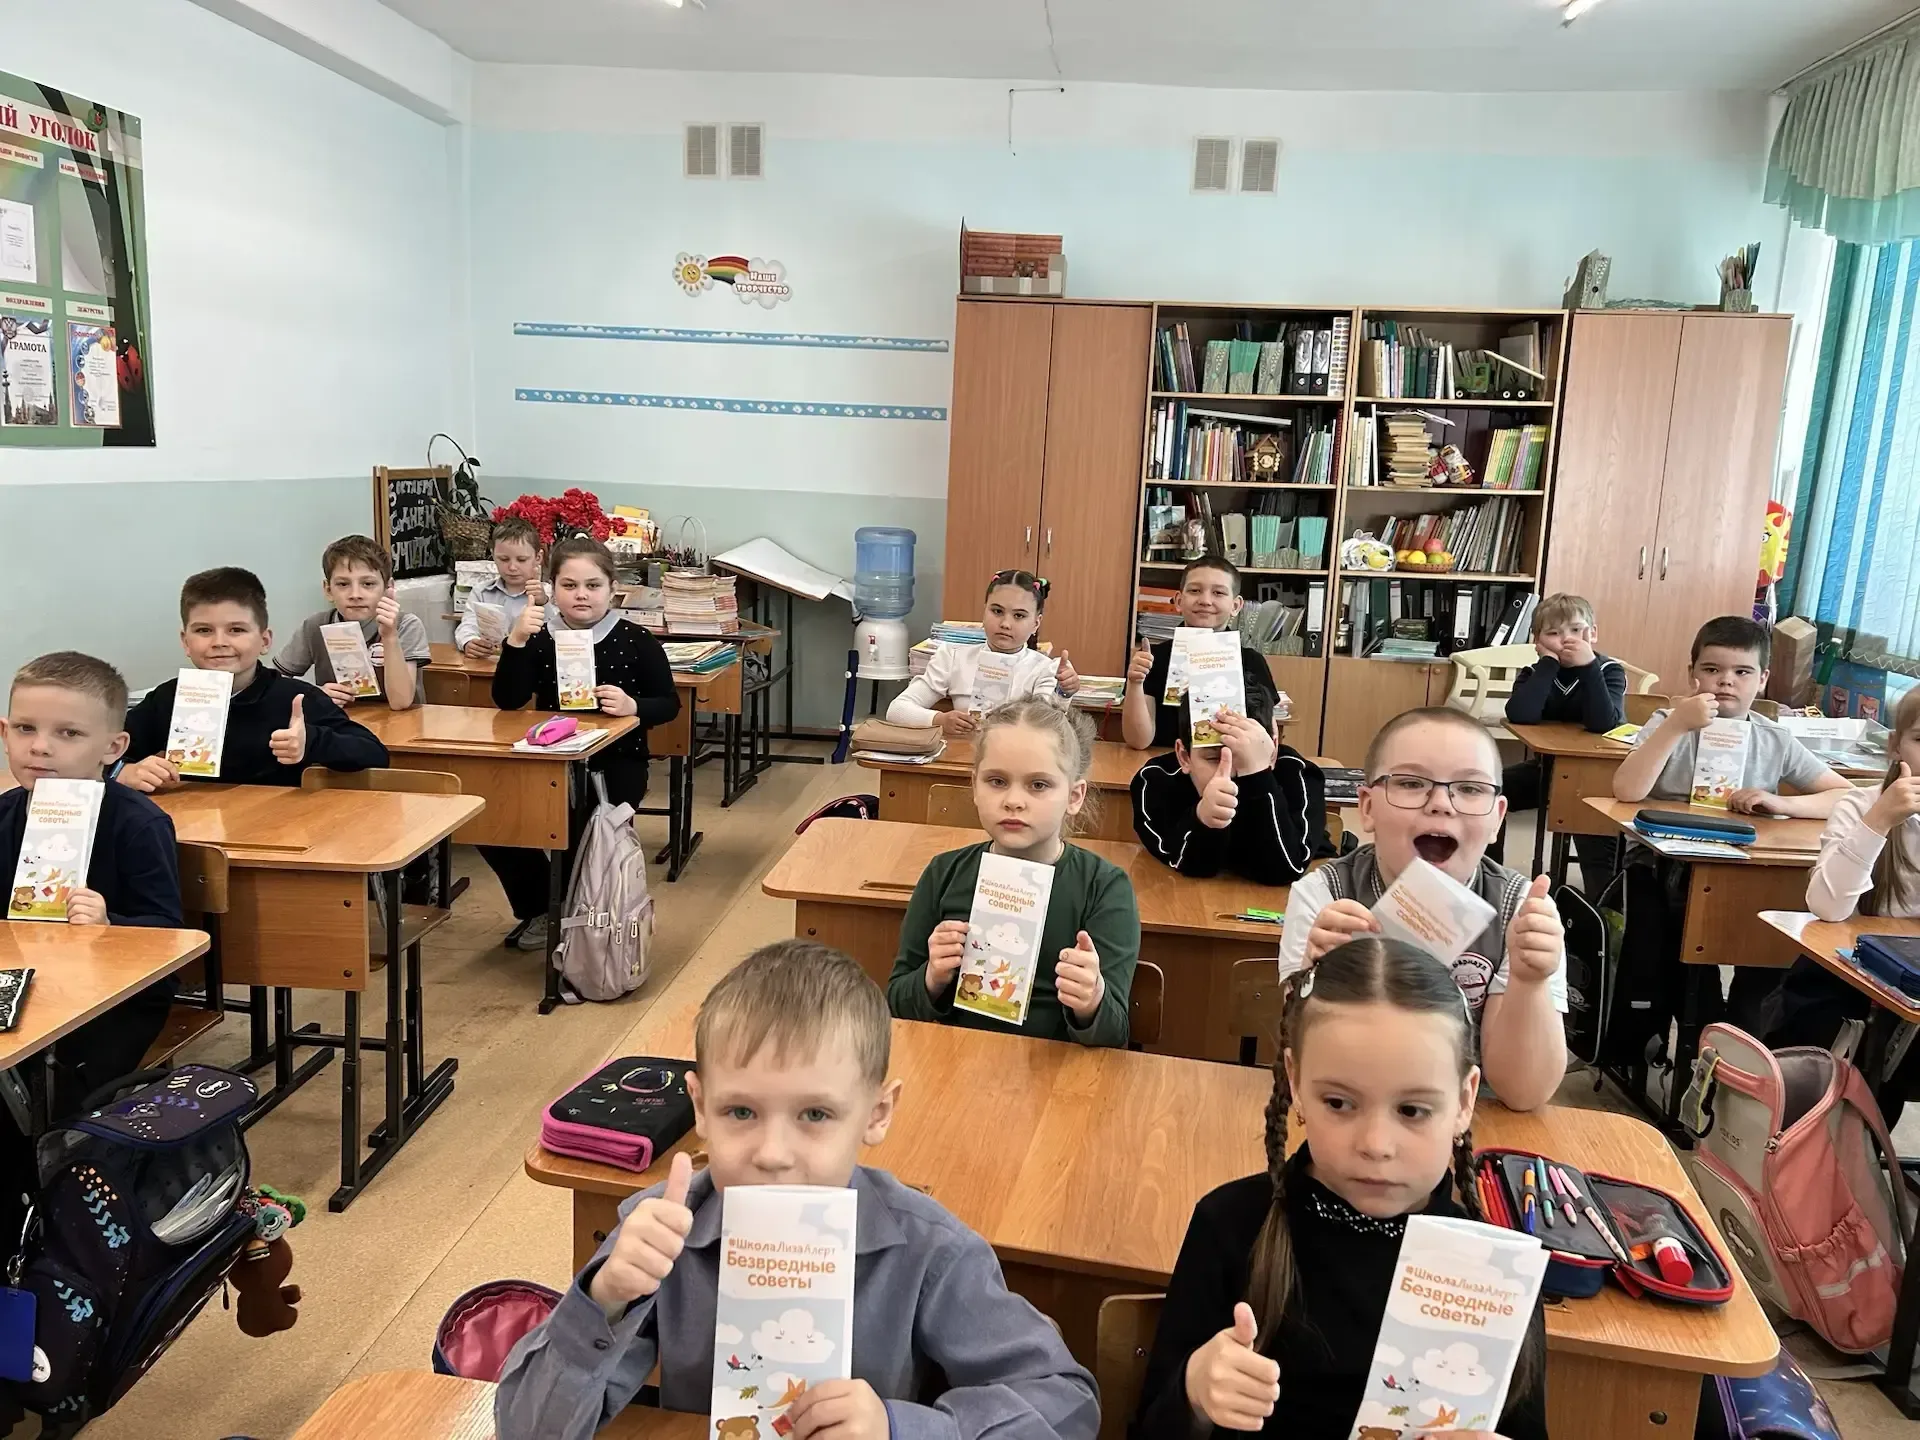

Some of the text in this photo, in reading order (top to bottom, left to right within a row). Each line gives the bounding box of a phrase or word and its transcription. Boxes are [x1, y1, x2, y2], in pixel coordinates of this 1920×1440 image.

[28, 113, 97, 152] УГОЛОК
[9, 341, 47, 353] ГРАМОТА
[978, 885, 1036, 907] Безвредные
[988, 898, 1022, 913] советы
[728, 1237, 836, 1257] #ШколаЛизаАлерт
[727, 1251, 836, 1275] Безвредные
[747, 1273, 812, 1289] советы
[1400, 1277, 1514, 1317] Безвредные
[1420, 1303, 1486, 1328] советы
